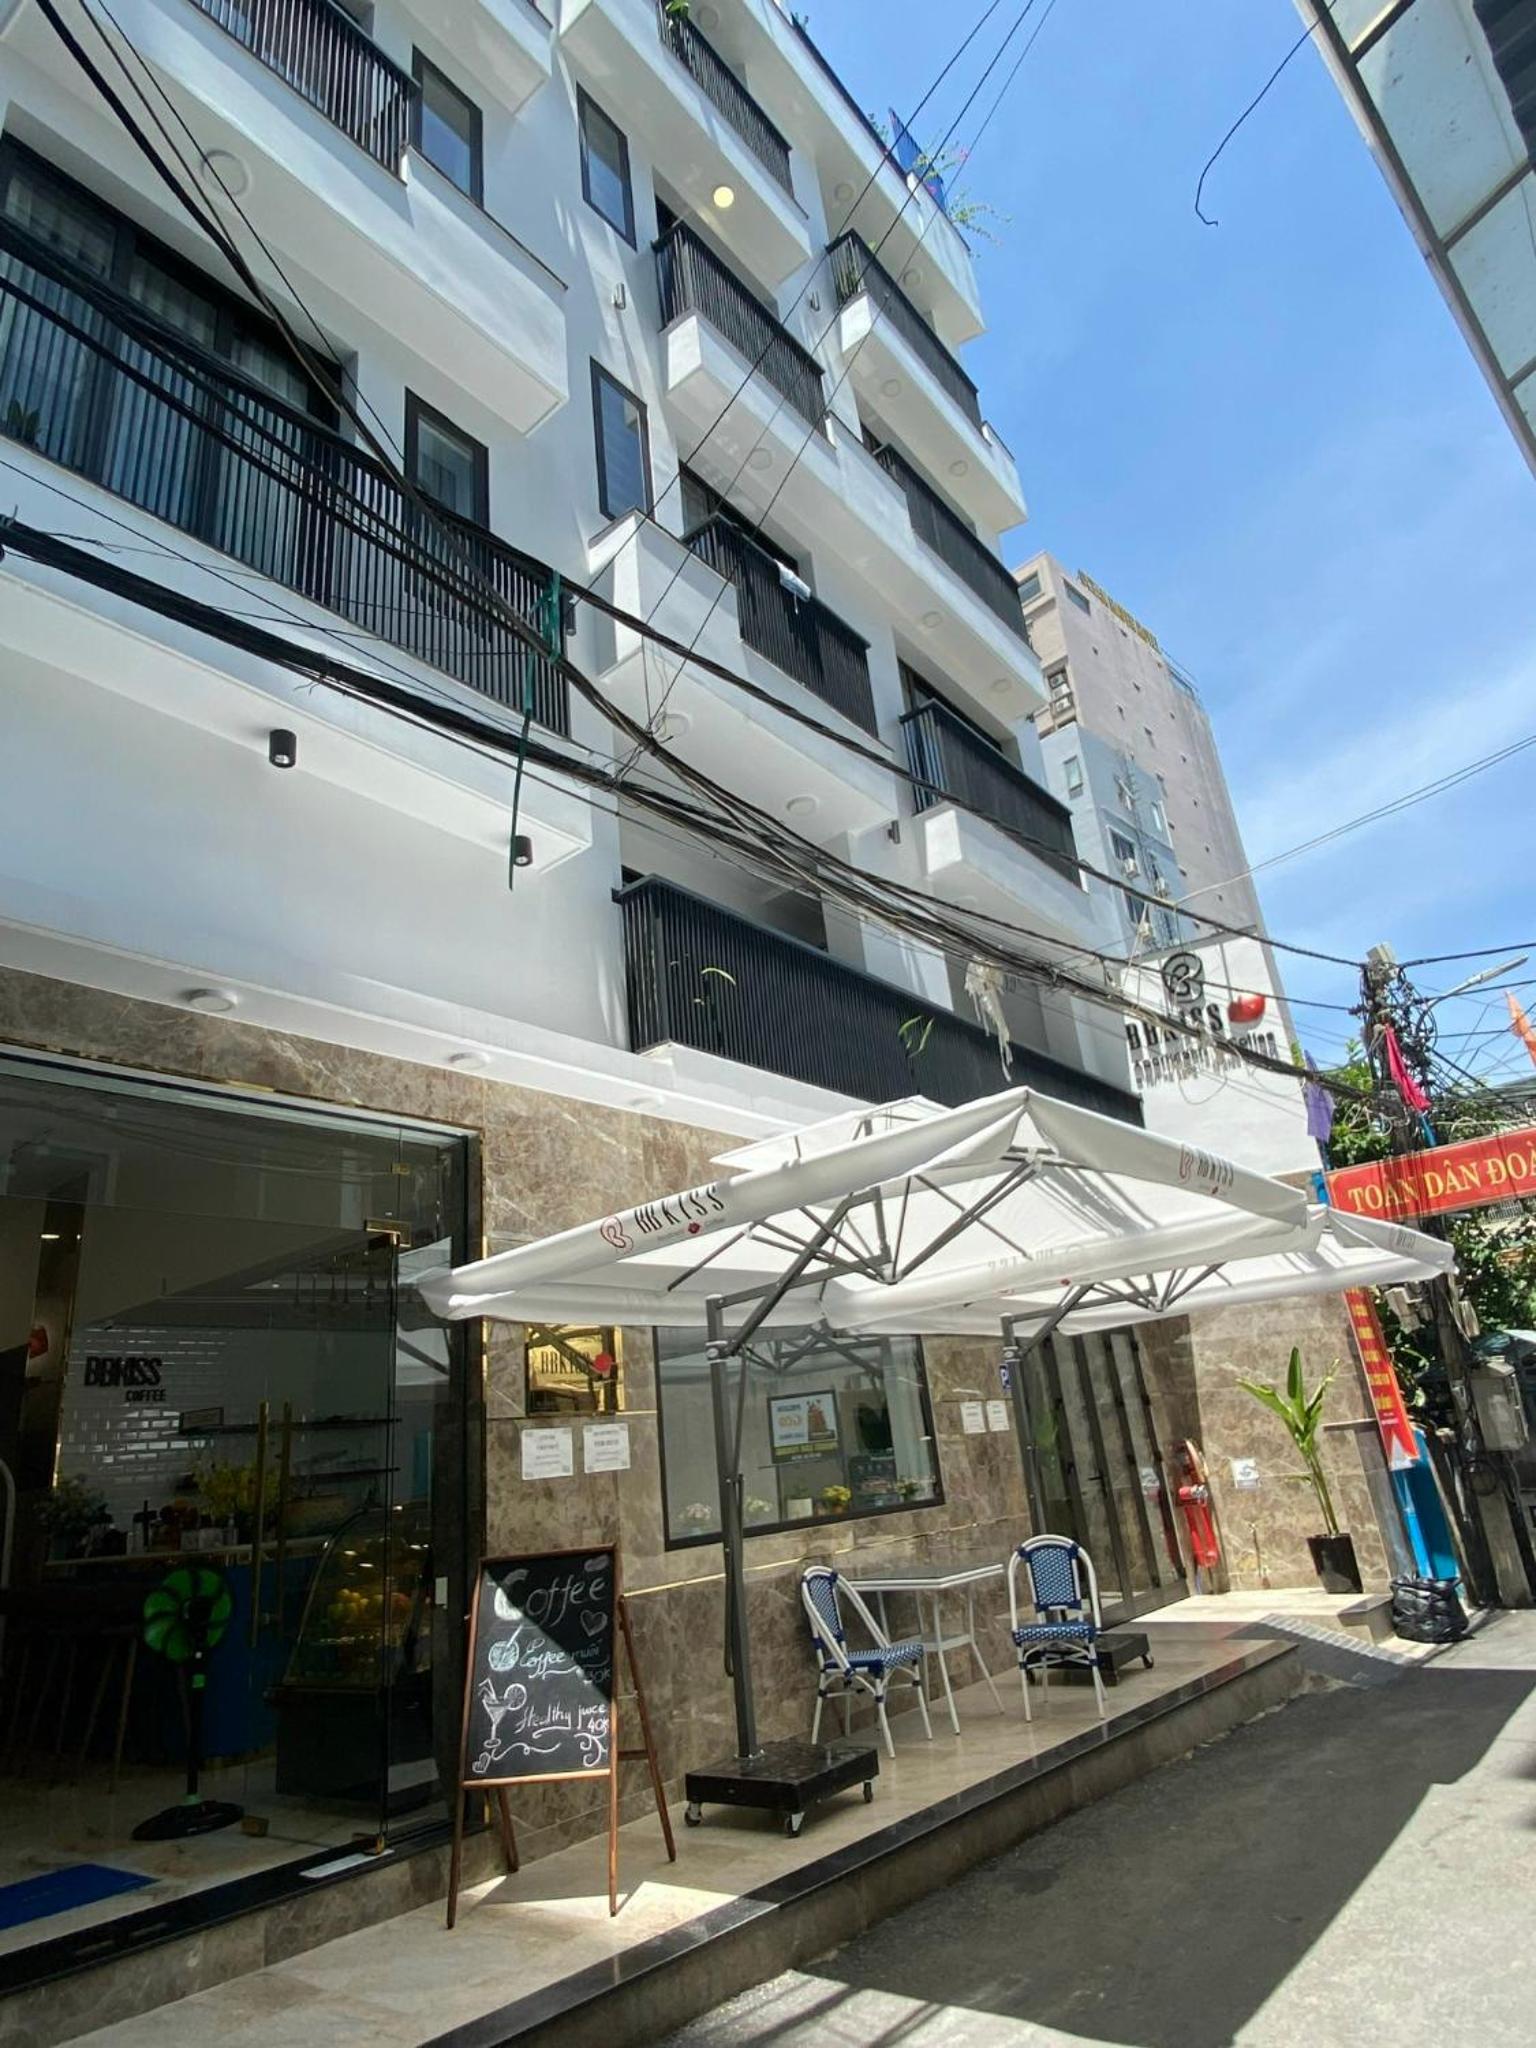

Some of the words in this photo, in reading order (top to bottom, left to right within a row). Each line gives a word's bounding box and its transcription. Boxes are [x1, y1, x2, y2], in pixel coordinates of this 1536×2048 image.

[1423, 1159, 1481, 1199] DÂN
[633, 1185, 726, 1235] BBKISS
[85, 1356, 163, 1386] BBKISS
[541, 1351, 591, 1375] BBKI
[126, 1388, 167, 1402] COFFEE
[494, 1568, 606, 1628] Coffee
[520, 1636, 568, 1679] Coffee
